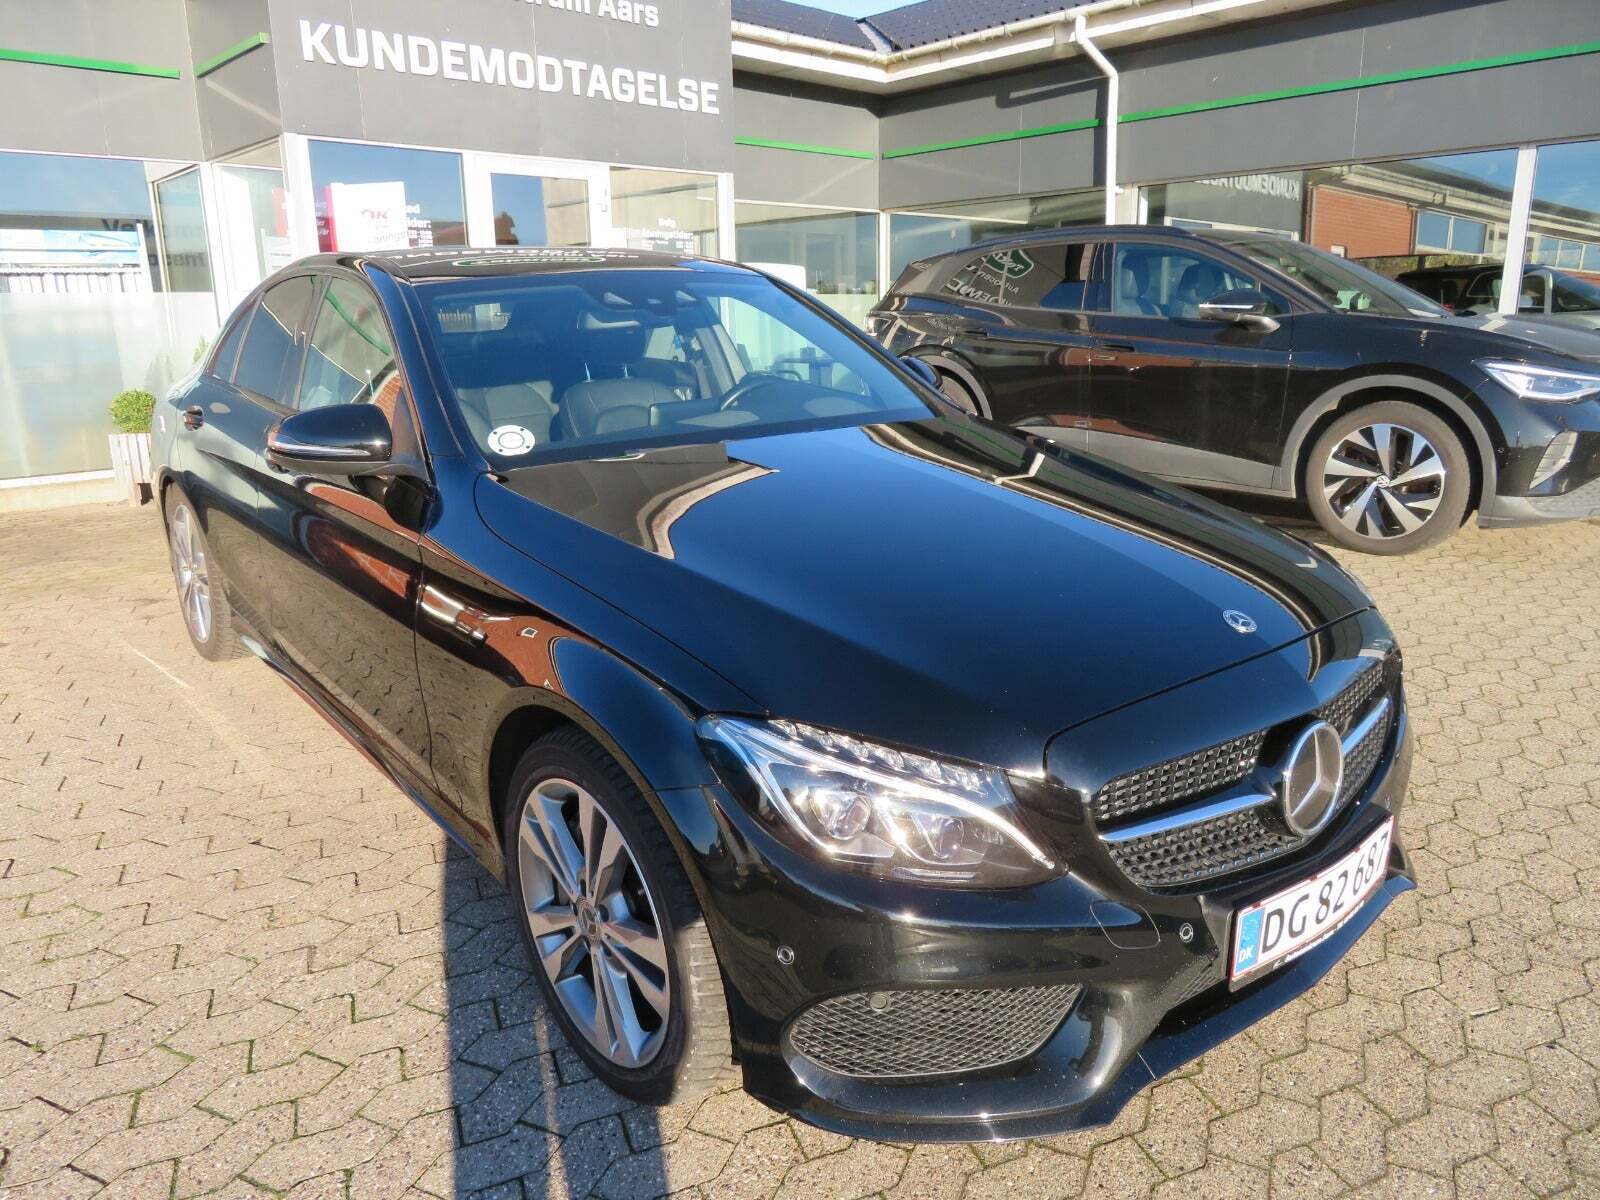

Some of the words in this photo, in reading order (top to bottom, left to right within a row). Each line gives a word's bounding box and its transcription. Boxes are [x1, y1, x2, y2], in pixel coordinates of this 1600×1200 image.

[599, 0, 659, 27] Aars
[299, 19, 720, 114] KUNDEMODTAGELSE
[1262, 894, 1310, 955] DG
[1315, 870, 1349, 925] 82
[1353, 831, 1389, 896] 687
[1239, 946, 1254, 963] DK
